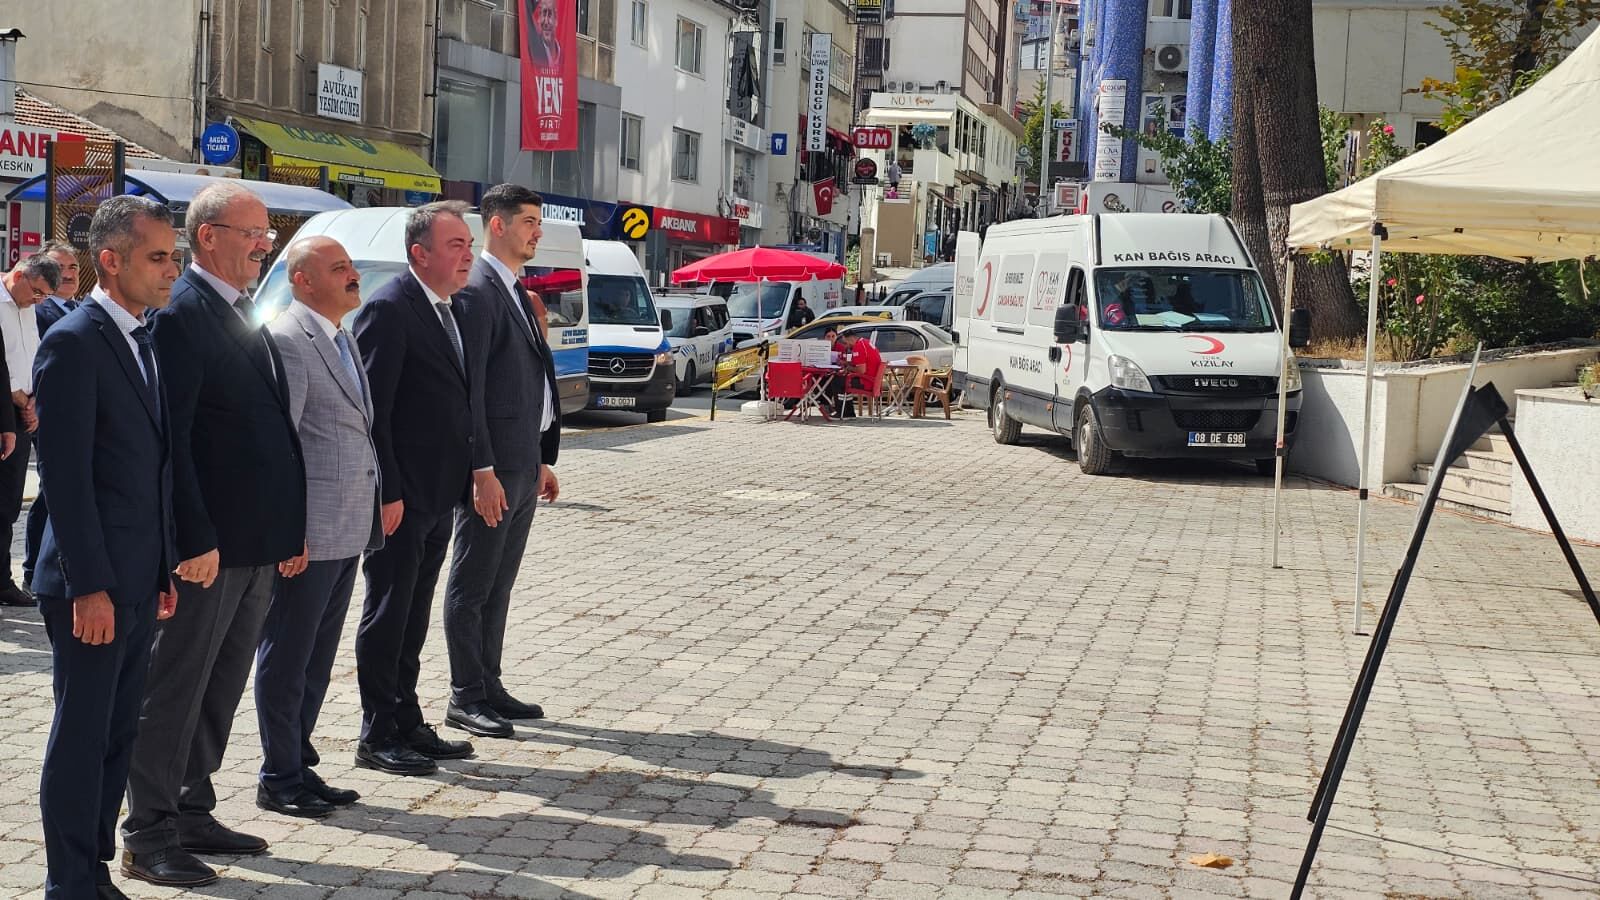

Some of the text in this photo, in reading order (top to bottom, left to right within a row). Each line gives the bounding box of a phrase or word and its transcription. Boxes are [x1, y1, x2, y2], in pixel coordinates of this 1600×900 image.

[322, 80, 359, 99] AVUKAT
[340, 97, 360, 118] GÜNER
[857, 130, 888, 146] BİM
[660, 215, 697, 233] AKBANK
[1113, 252, 1144, 263] KAN
[1195, 253, 1236, 265] ARACI
[1190, 360, 1234, 368] KIZILAY
[1194, 378, 1239, 388] IVECO
[1195, 432, 1243, 444] 08 DE 698
